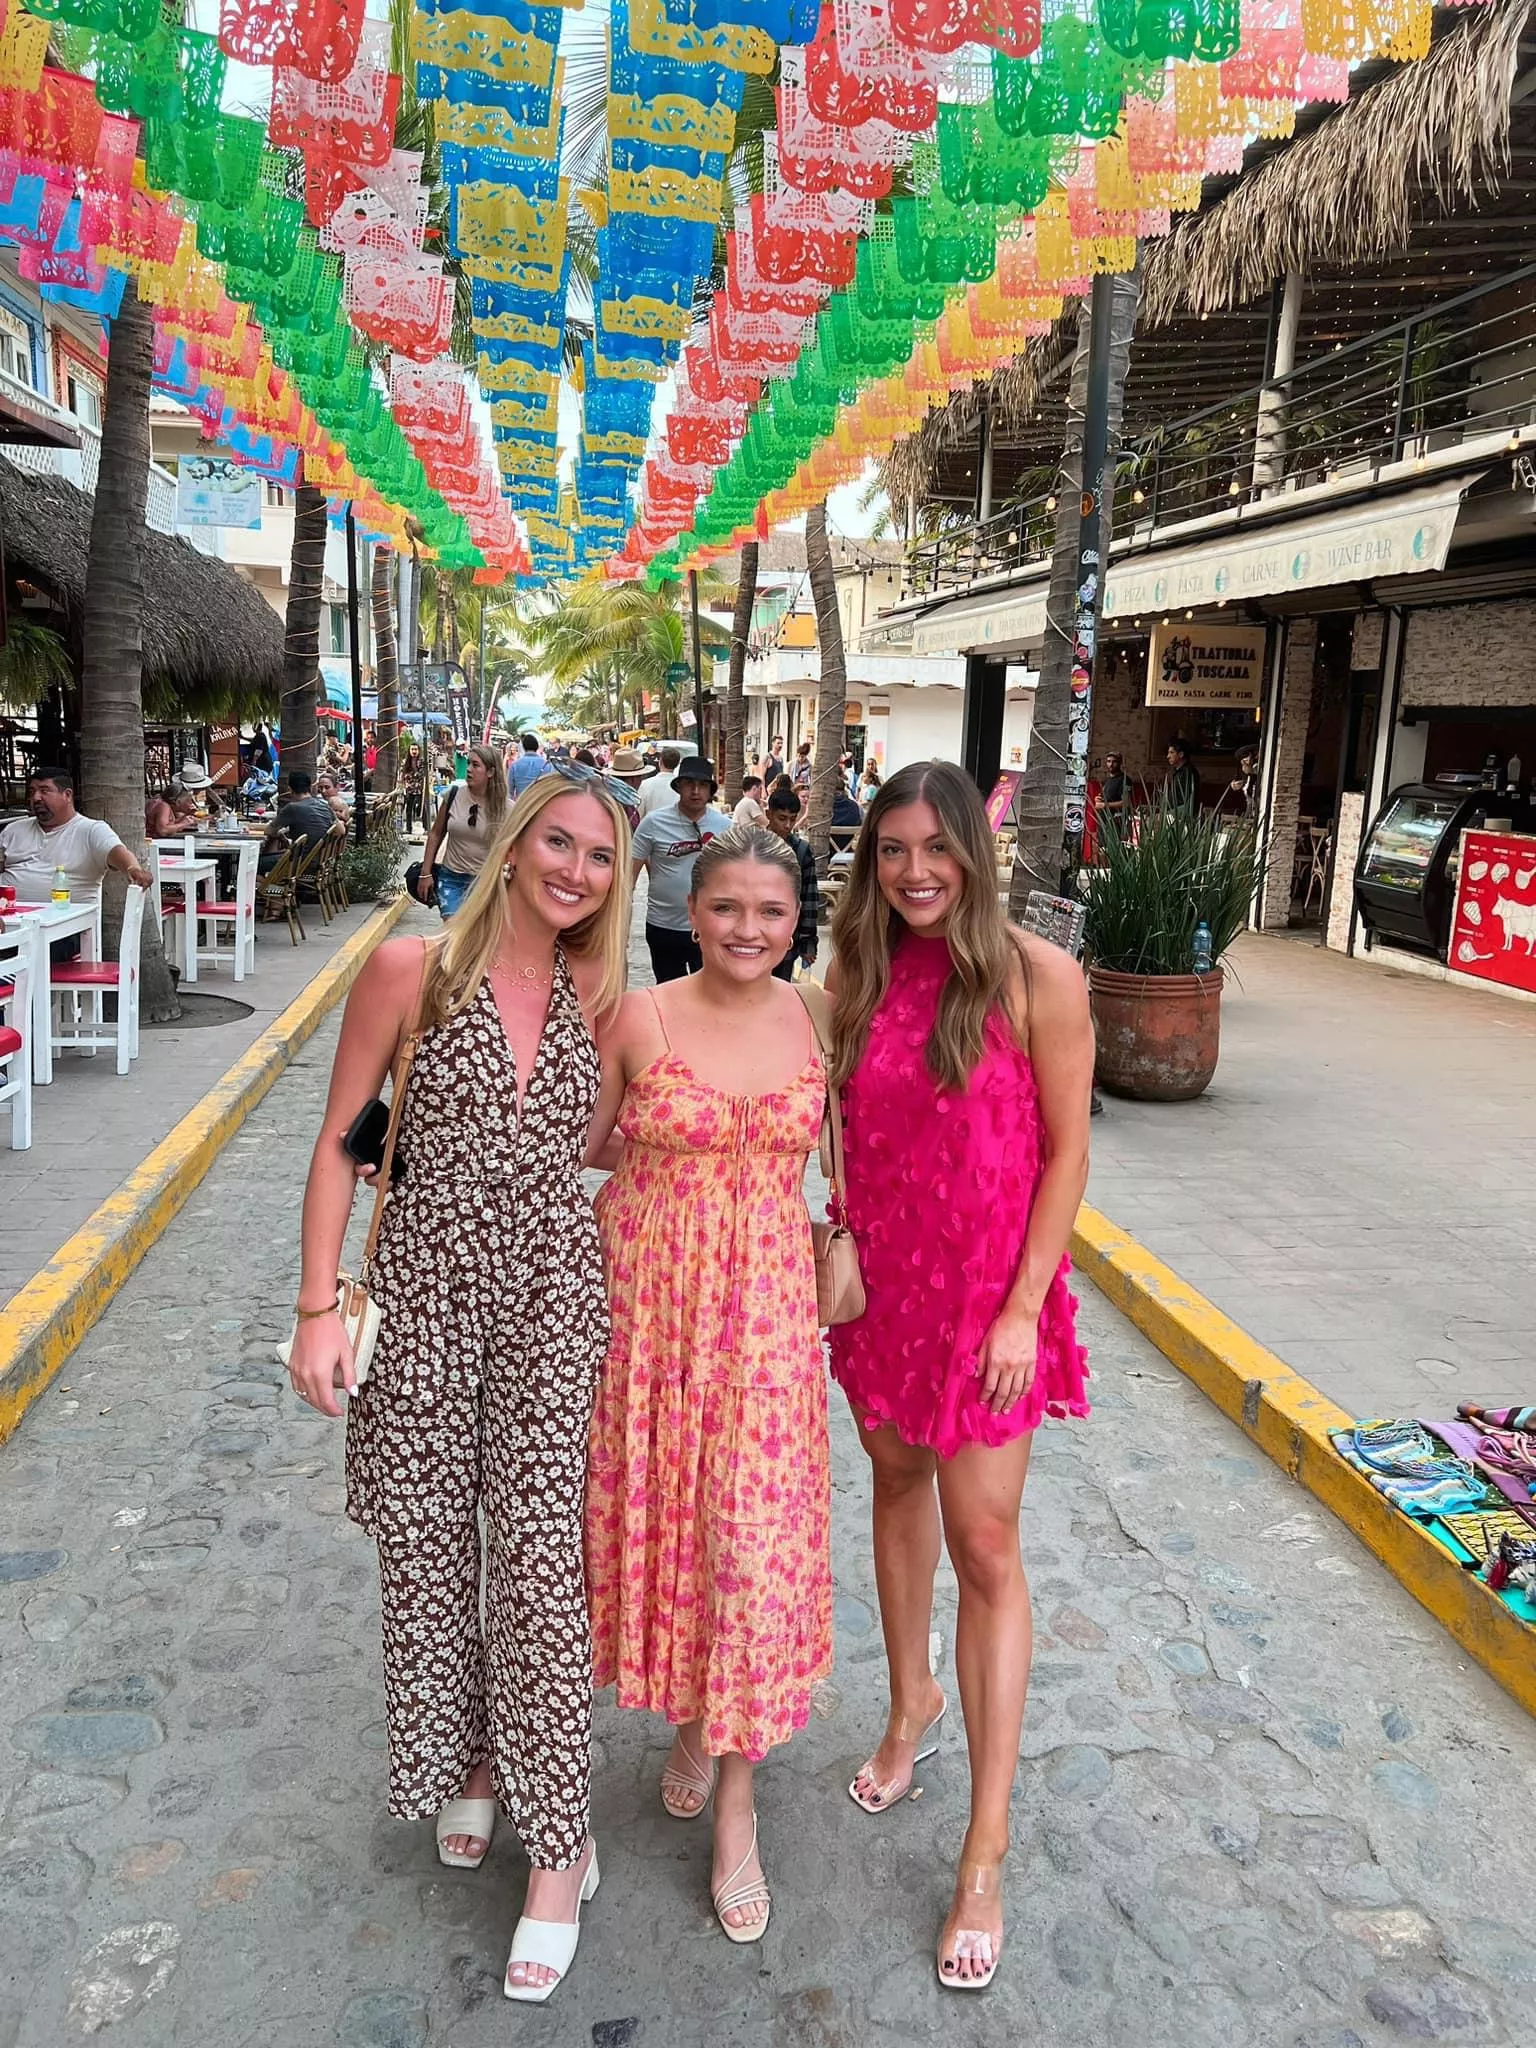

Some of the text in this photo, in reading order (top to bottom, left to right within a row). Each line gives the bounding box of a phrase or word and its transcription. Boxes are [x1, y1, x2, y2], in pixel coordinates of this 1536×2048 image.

[1123, 538, 1393, 603] PIZZA PASTA CARNE WINE BAR
[1191, 646, 1257, 661] TRATTORIA
[1197, 665, 1250, 679] TOSCANA
[1158, 689, 1179, 698] PIZZA
[1183, 690, 1206, 698] PASTA
[1209, 690, 1232, 699] CARNE
